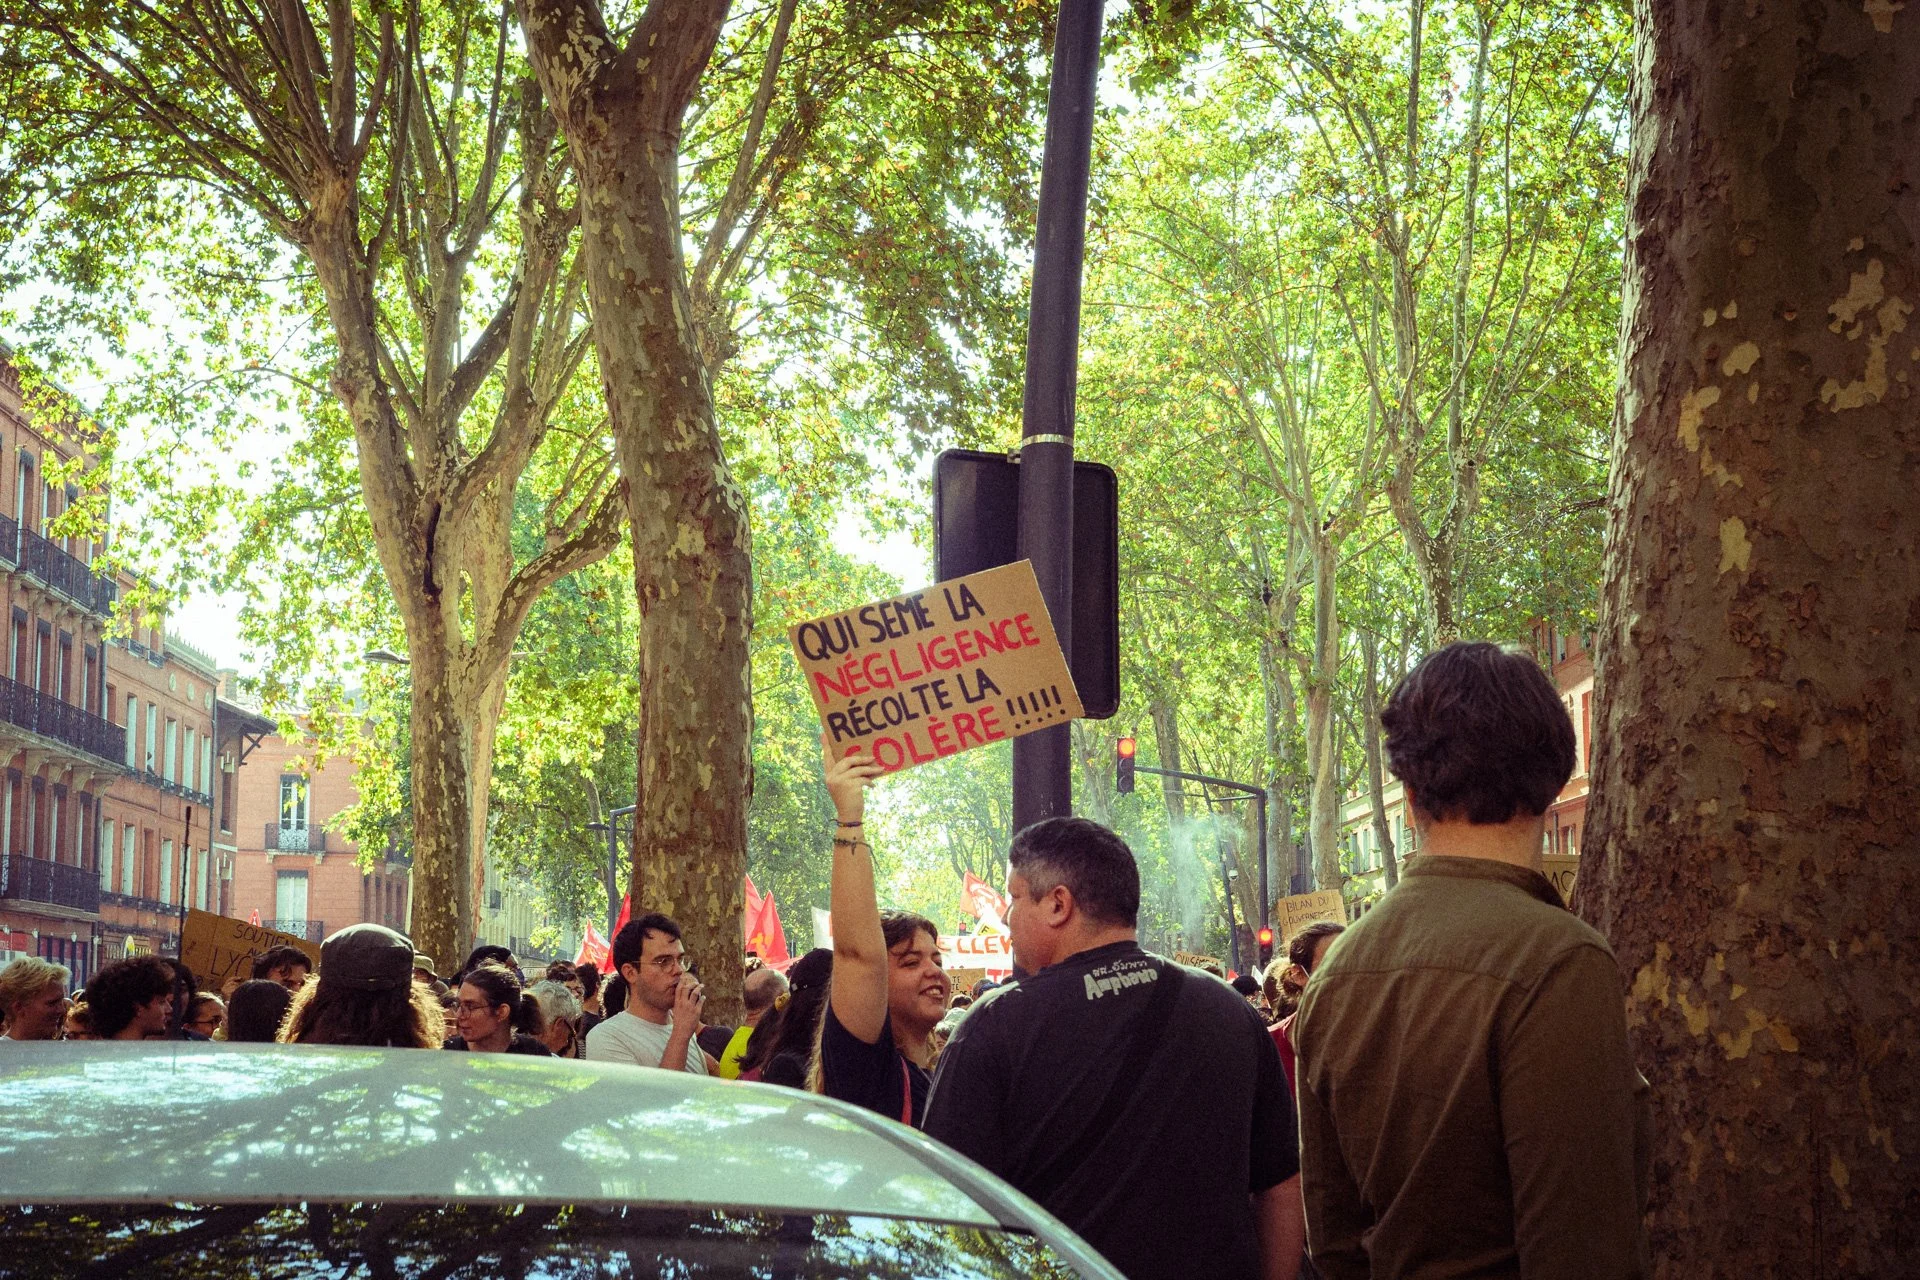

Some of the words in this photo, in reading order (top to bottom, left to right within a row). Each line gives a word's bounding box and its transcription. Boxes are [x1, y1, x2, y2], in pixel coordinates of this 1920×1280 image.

[798, 615, 859, 661] QUI
[859, 594, 935, 643] SEME
[943, 583, 985, 622] LA
[813, 613, 1040, 704] NÉGLIGENCE
[827, 679, 953, 743] RÉCOLTE
[956, 668, 1002, 704] LA
